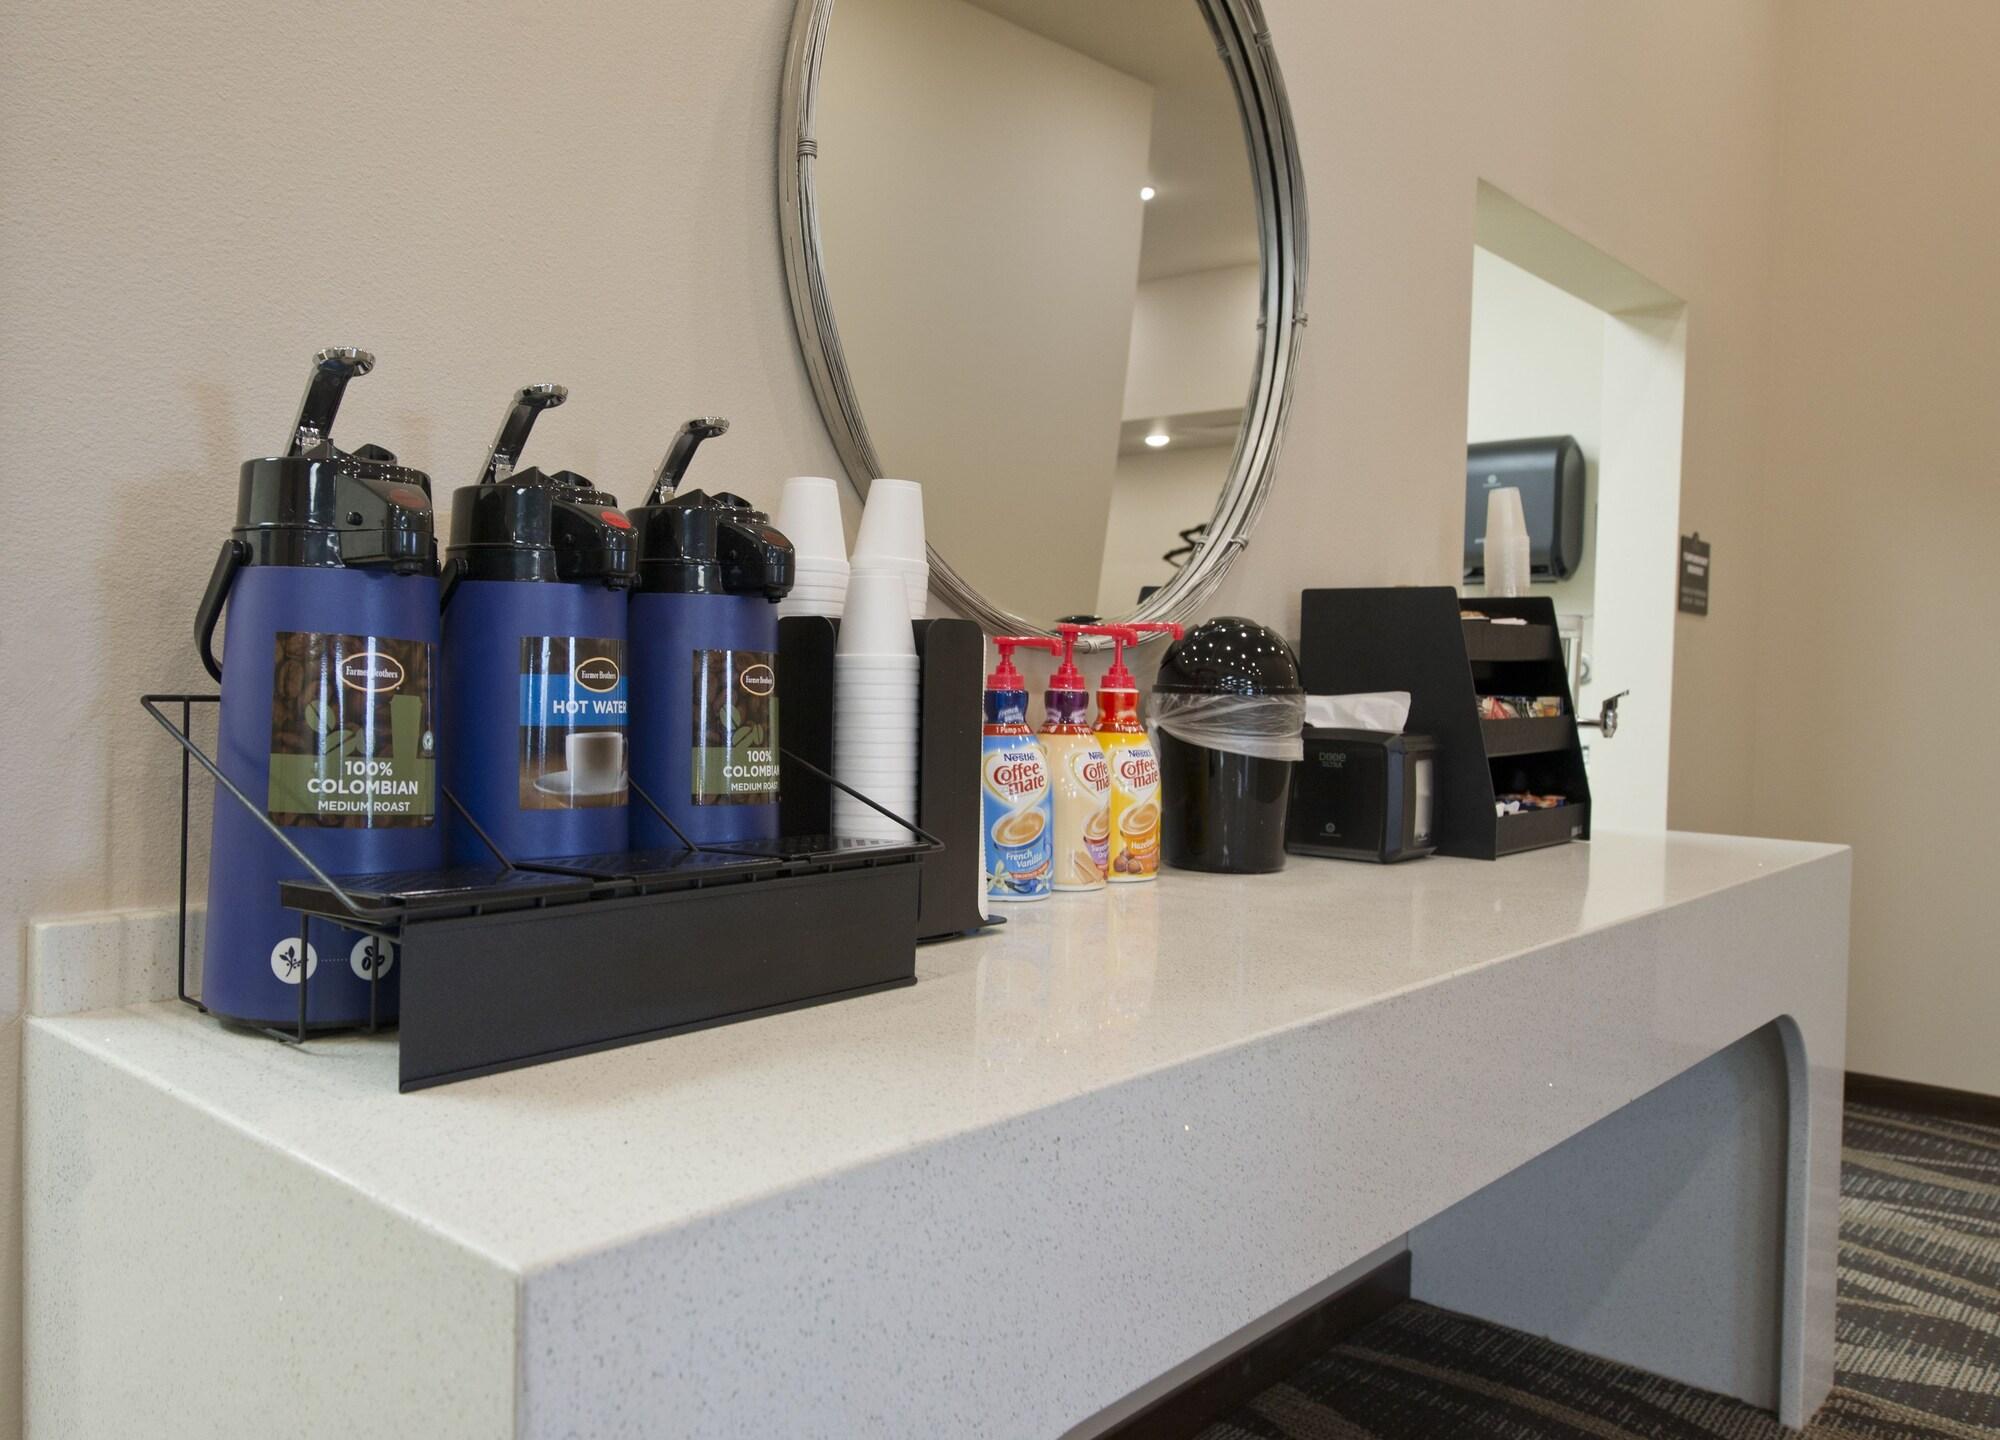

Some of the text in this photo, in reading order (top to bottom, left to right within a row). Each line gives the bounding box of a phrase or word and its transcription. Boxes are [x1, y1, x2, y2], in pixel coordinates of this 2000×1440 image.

[346, 665, 398, 679] Farme rothers
[553, 700, 627, 714] HOT WATER
[747, 750, 772, 762] 100%
[345, 761, 393, 776] 100%
[307, 778, 418, 795] COLOMBIAN
[731, 782, 762, 791] MEDIUM
[1096, 776, 1109, 792] ma
[318, 801, 410, 812] MEDIUM ROAST
[1006, 848, 1033, 861] French
